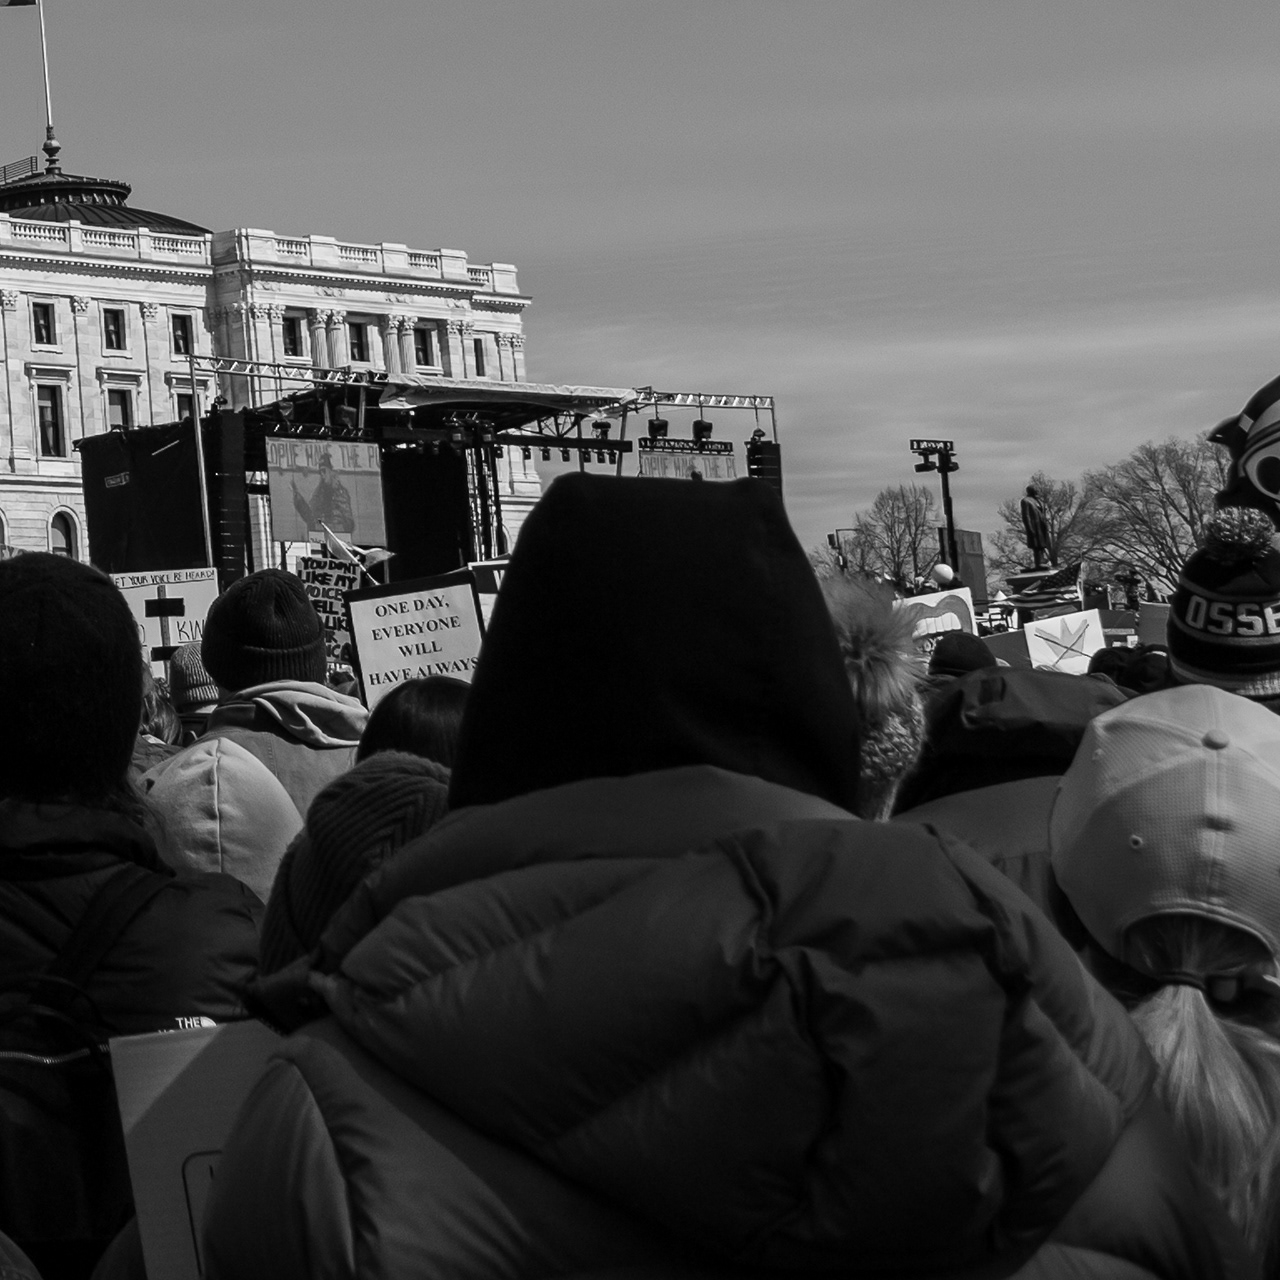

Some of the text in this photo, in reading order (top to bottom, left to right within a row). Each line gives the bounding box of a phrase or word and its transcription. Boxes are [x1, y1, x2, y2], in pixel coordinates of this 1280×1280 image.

[375, 595, 450, 618] ONE DAY,
[371, 615, 461, 641] EVERYONE
[398, 640, 443, 658] WILL
[368, 656, 479, 686] HAVE ALWAYS
[174, 1016, 201, 1030] THE
